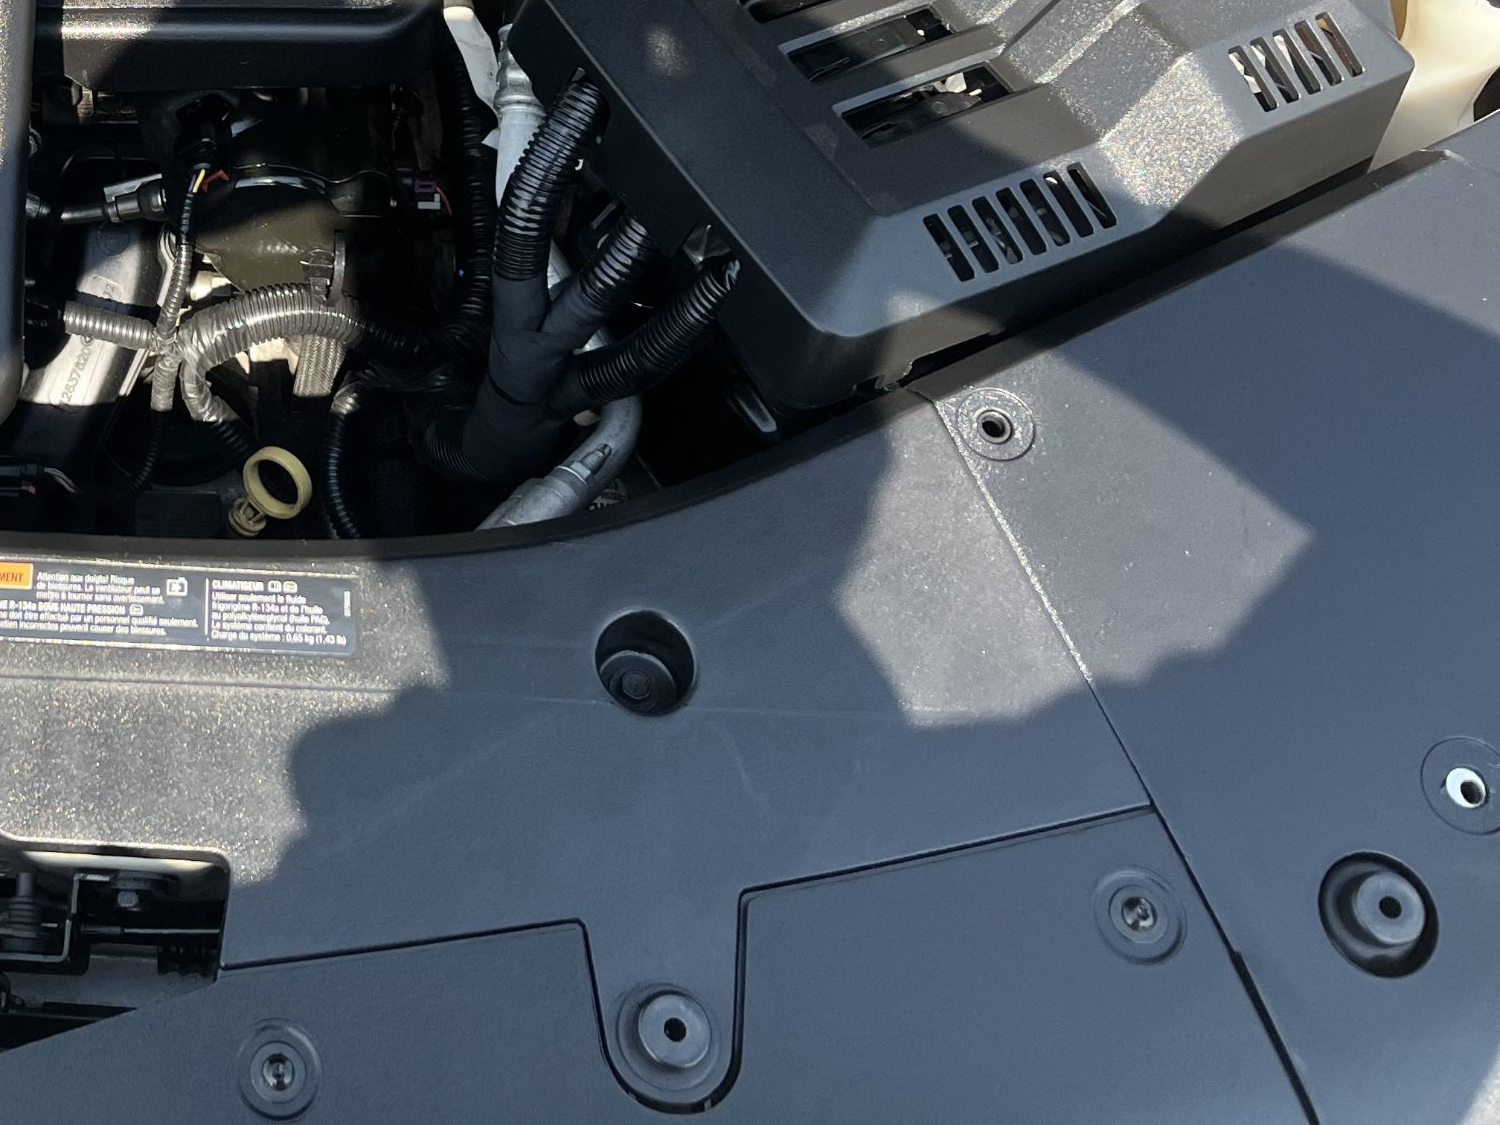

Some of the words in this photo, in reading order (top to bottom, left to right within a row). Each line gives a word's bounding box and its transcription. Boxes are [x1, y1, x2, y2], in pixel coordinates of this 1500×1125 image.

[37, 572, 69, 582] Attention
[110, 575, 135, 585] Risque
[212, 579, 264, 591] CLIMATISEUR
[37, 582, 46, 590] de
[85, 583, 94, 592] Le
[134, 586, 150, 595] peut
[152, 587, 160, 595] se
[67, 592, 93, 601] tourner
[95, 594, 112, 602] sans
[212, 591, 237, 602] Utiliser
[277, 594, 284, 603] le
[286, 595, 306, 605] fluide
[9, 600, 37, 610] R-134a
[38, 602, 59, 611] SOUS
[60, 603, 85, 613] HAUTE
[87, 604, 125, 615] PRESSION
[252, 603, 279, 613] R-134a
[280, 605, 288, 613] et
[290, 605, 299, 614] de
[9, 610, 22, 619] doit
[70, 615, 82, 623] par
[84, 615, 94, 623] un
[94, 616, 130, 625] personnel
[19, 621, 58, 630] incorrectes
[60, 623, 88, 633] peuvent
[90, 625, 114, 633] causer
[116, 625, 129, 634] des
[212, 620, 221, 629] Le
[254, 623, 283, 632] contient
[285, 624, 294, 632] du
[212, 630, 237, 641] Charge
[239, 631, 248, 640] du
[304, 634, 314, 645] kg
